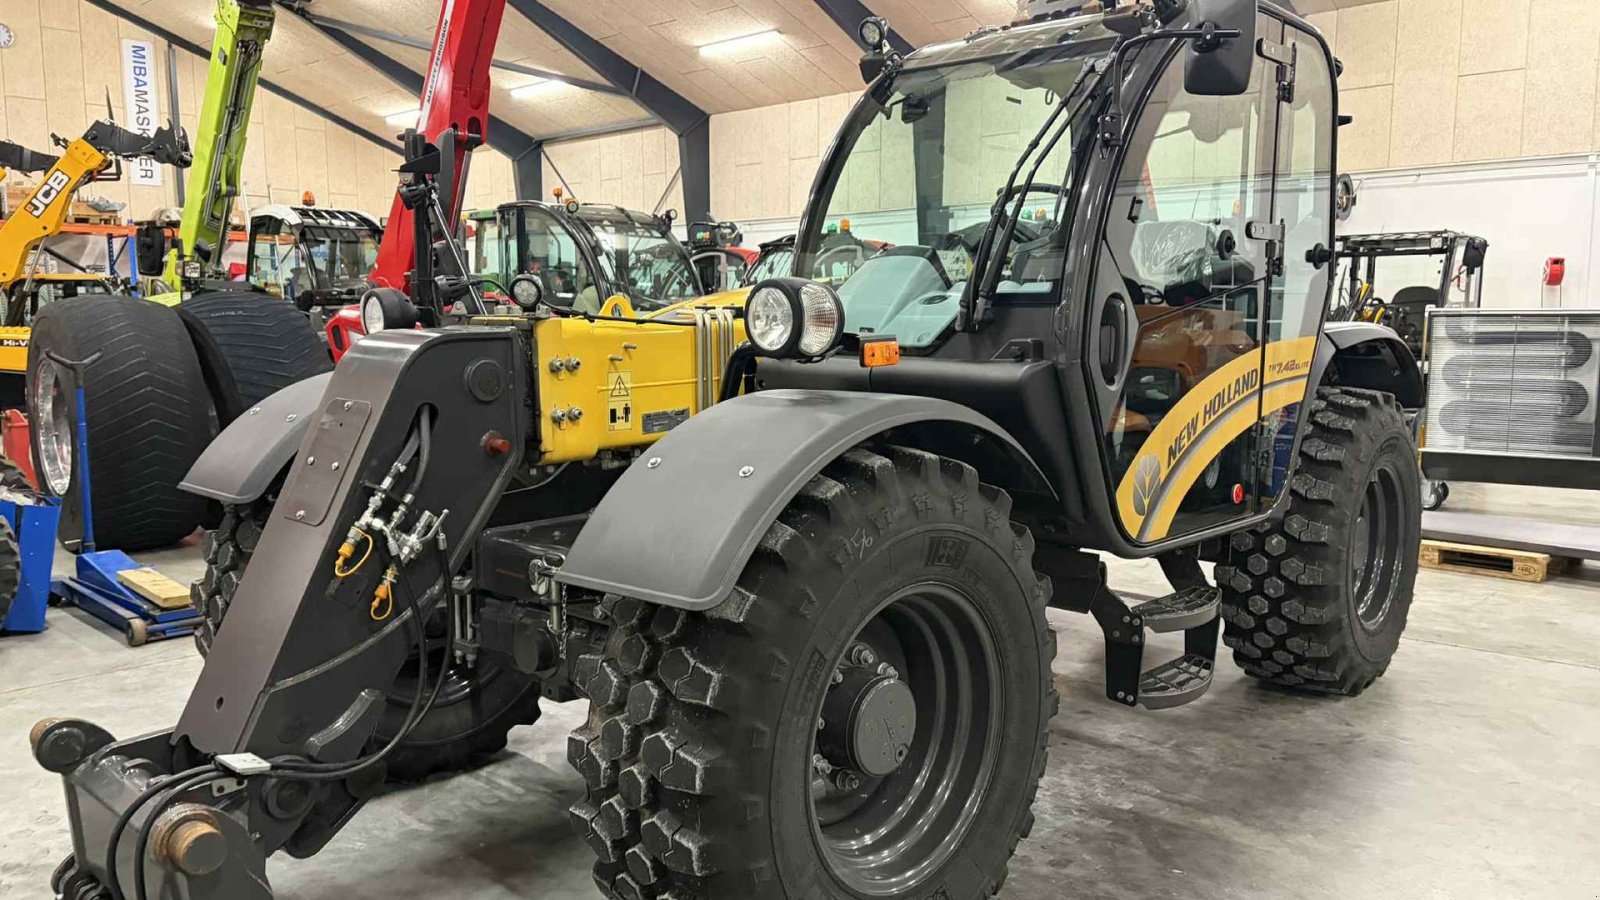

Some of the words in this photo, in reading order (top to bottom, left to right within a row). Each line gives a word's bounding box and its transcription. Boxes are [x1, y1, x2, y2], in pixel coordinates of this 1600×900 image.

[131, 44, 154, 179] MIBAMASKER
[29, 170, 70, 216] JCB
[1167, 412, 1200, 468] NEW
[1203, 368, 1258, 426] HOLLAND
